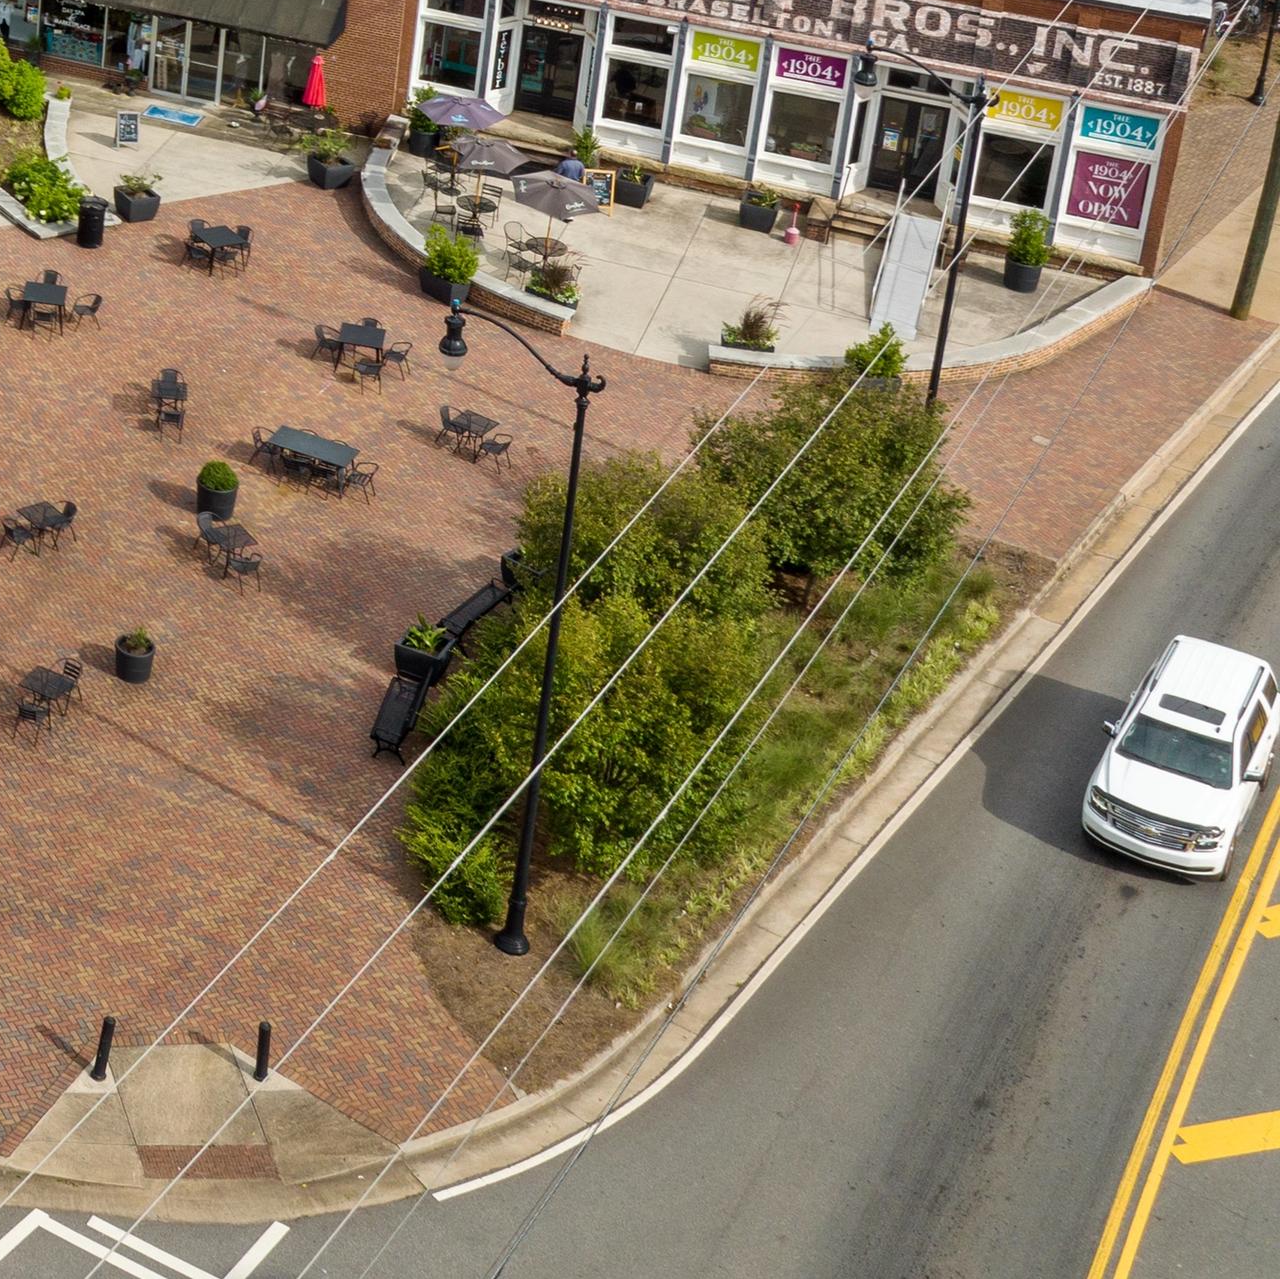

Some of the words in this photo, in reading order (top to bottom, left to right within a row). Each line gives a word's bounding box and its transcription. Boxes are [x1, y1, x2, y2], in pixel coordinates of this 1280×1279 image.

[703, 42, 747, 64] 1904
[719, 38, 735, 47] THE
[870, 29, 920, 55] GA.
[1032, 25, 1150, 75] INC.
[789, 58, 834, 80] 1904
[804, 54, 822, 64] THE
[1094, 71, 1124, 89] EST.
[1126, 74, 1167, 96] 1887
[1001, 100, 1048, 123] 1904
[1113, 113, 1131, 123] THE
[1095, 118, 1143, 141] 1904
[1093, 163, 1128, 182] 1904
[1088, 180, 1127, 199] NOW
[1078, 199, 1129, 221] OPEN
